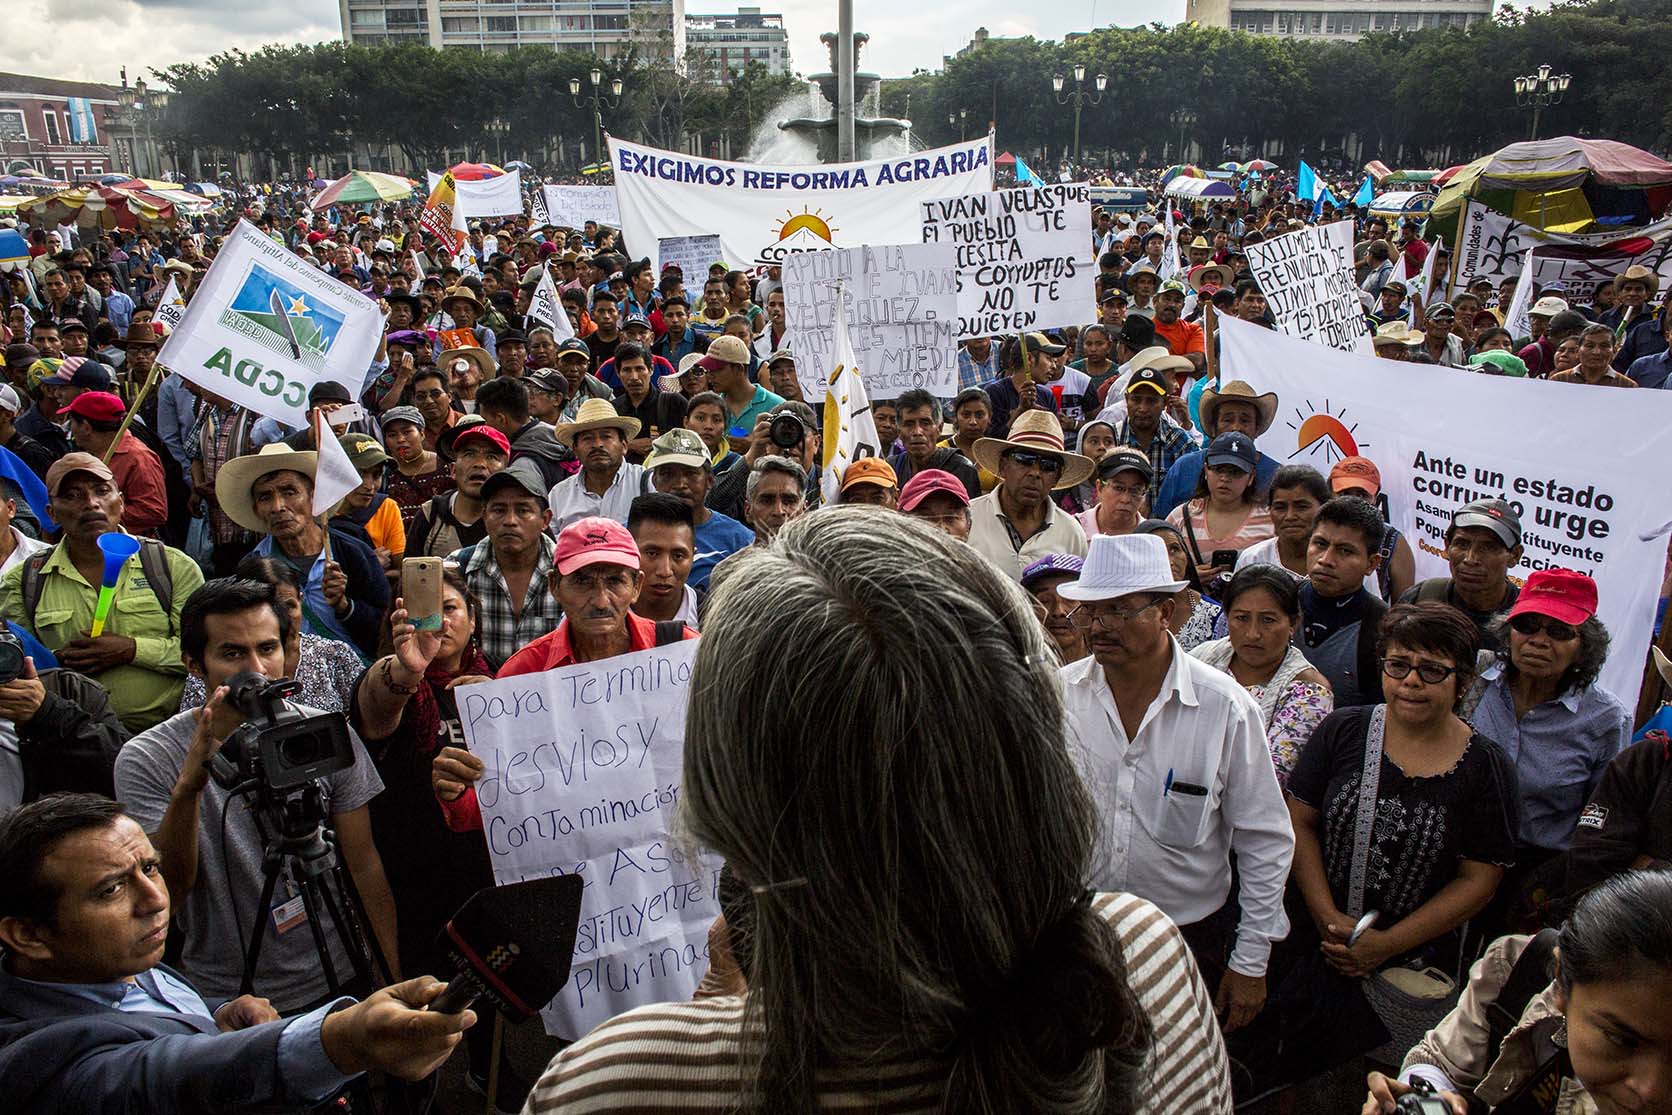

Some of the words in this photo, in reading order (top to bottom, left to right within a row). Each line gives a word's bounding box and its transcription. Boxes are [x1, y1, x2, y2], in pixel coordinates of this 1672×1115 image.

[618, 148, 736, 187] EXIGIMOS
[743, 167, 869, 190] REFORMA
[875, 145, 988, 187] AGRARIA
[1035, 209, 1067, 232] TE
[1317, 227, 1332, 250] LA
[1461, 225, 1482, 278] Comunidades
[1472, 210, 1484, 222] de
[1331, 246, 1347, 271] DE
[977, 286, 1014, 314] NO
[1027, 280, 1060, 304] TE
[1413, 450, 1467, 480] Ante
[1474, 467, 1505, 489] un
[1513, 476, 1614, 512] estado
[1535, 506, 1610, 541] urge
